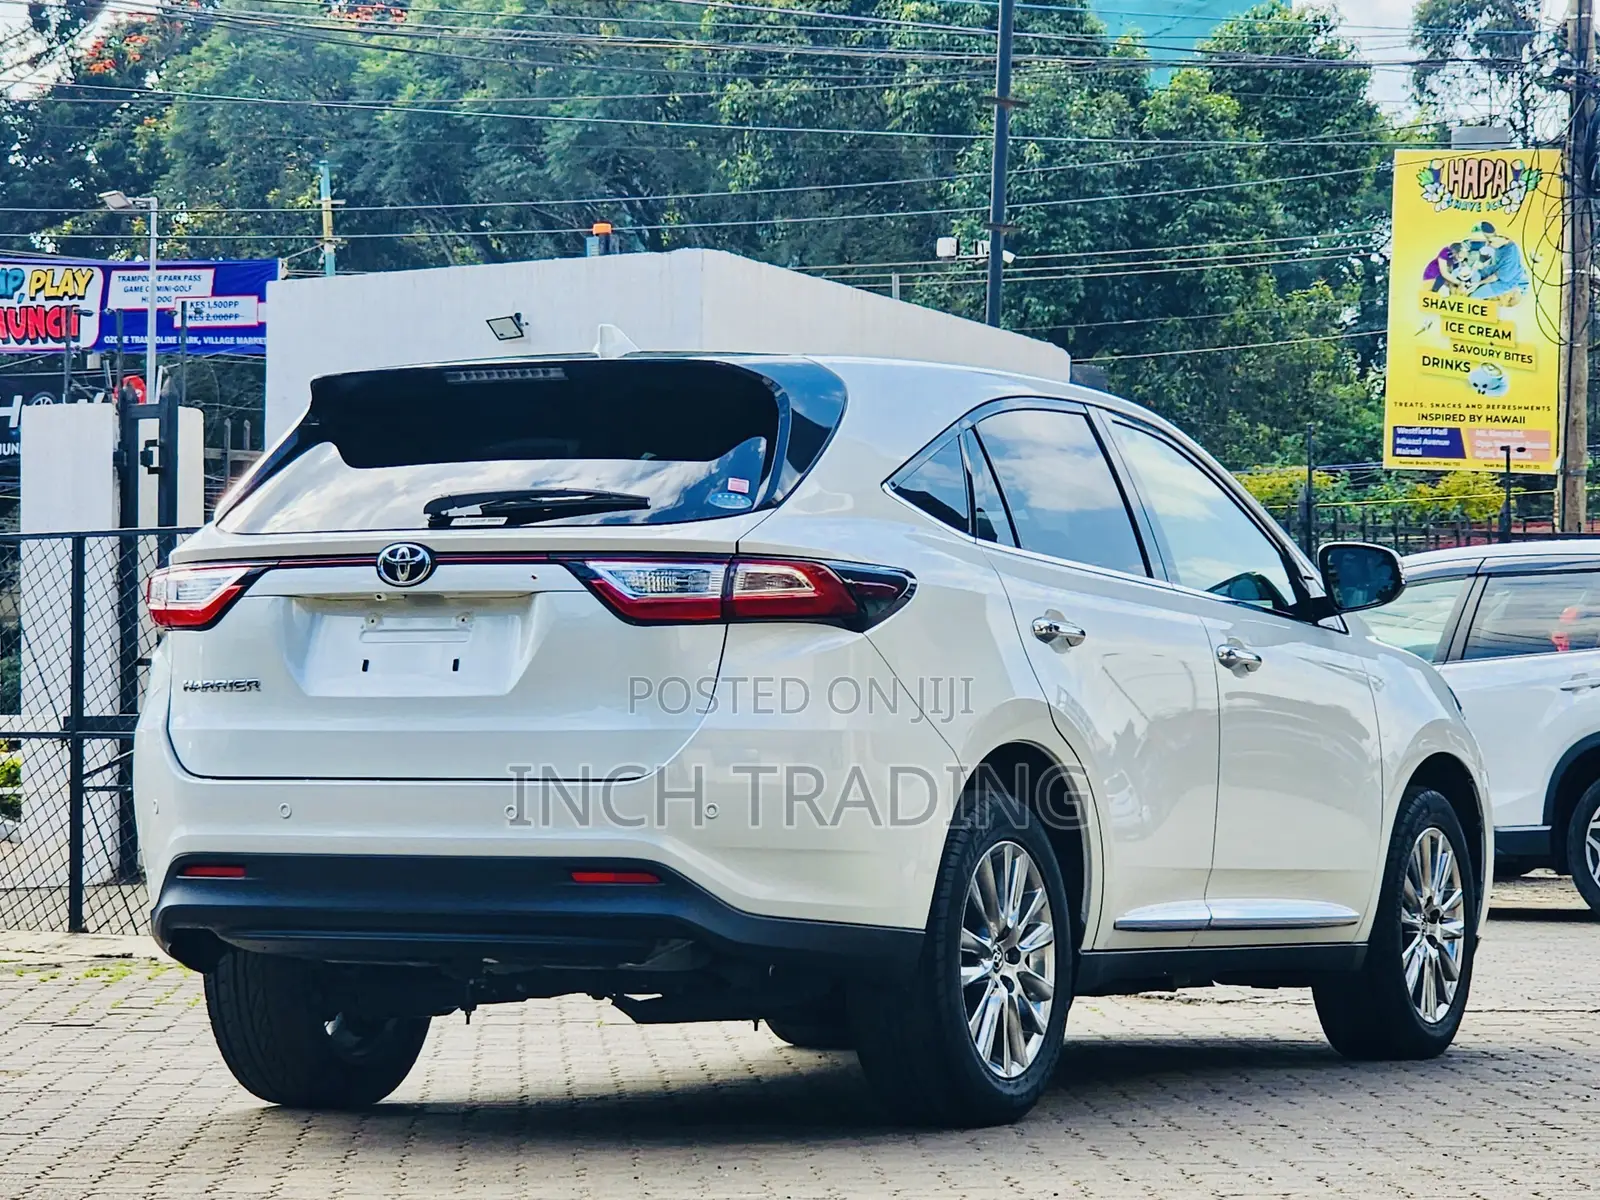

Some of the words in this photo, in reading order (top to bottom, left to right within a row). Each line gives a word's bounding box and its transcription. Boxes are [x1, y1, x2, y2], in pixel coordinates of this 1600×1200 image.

[1448, 158, 1508, 200] HAPA
[29, 267, 94, 301] PLAY
[183, 274, 202, 282] PASS
[1422, 297, 1464, 313] SHAVE
[1467, 303, 1488, 317] ICE
[1445, 321, 1465, 334] ICE
[1468, 325, 1512, 341] CREAM
[203, 336, 235, 345] VILLAGE
[1453, 343, 1501, 359] SAVOURY
[1504, 351, 1533, 364] BITES
[1422, 356, 1471, 373] DRINKS
[1486, 404, 1551, 412] REFRESHMENTS
[1417, 412, 1466, 422] INSPIRED
[1469, 414, 1483, 423] BY
[1486, 415, 1526, 424] HAWAII
[182, 678, 262, 693] HARRIER
